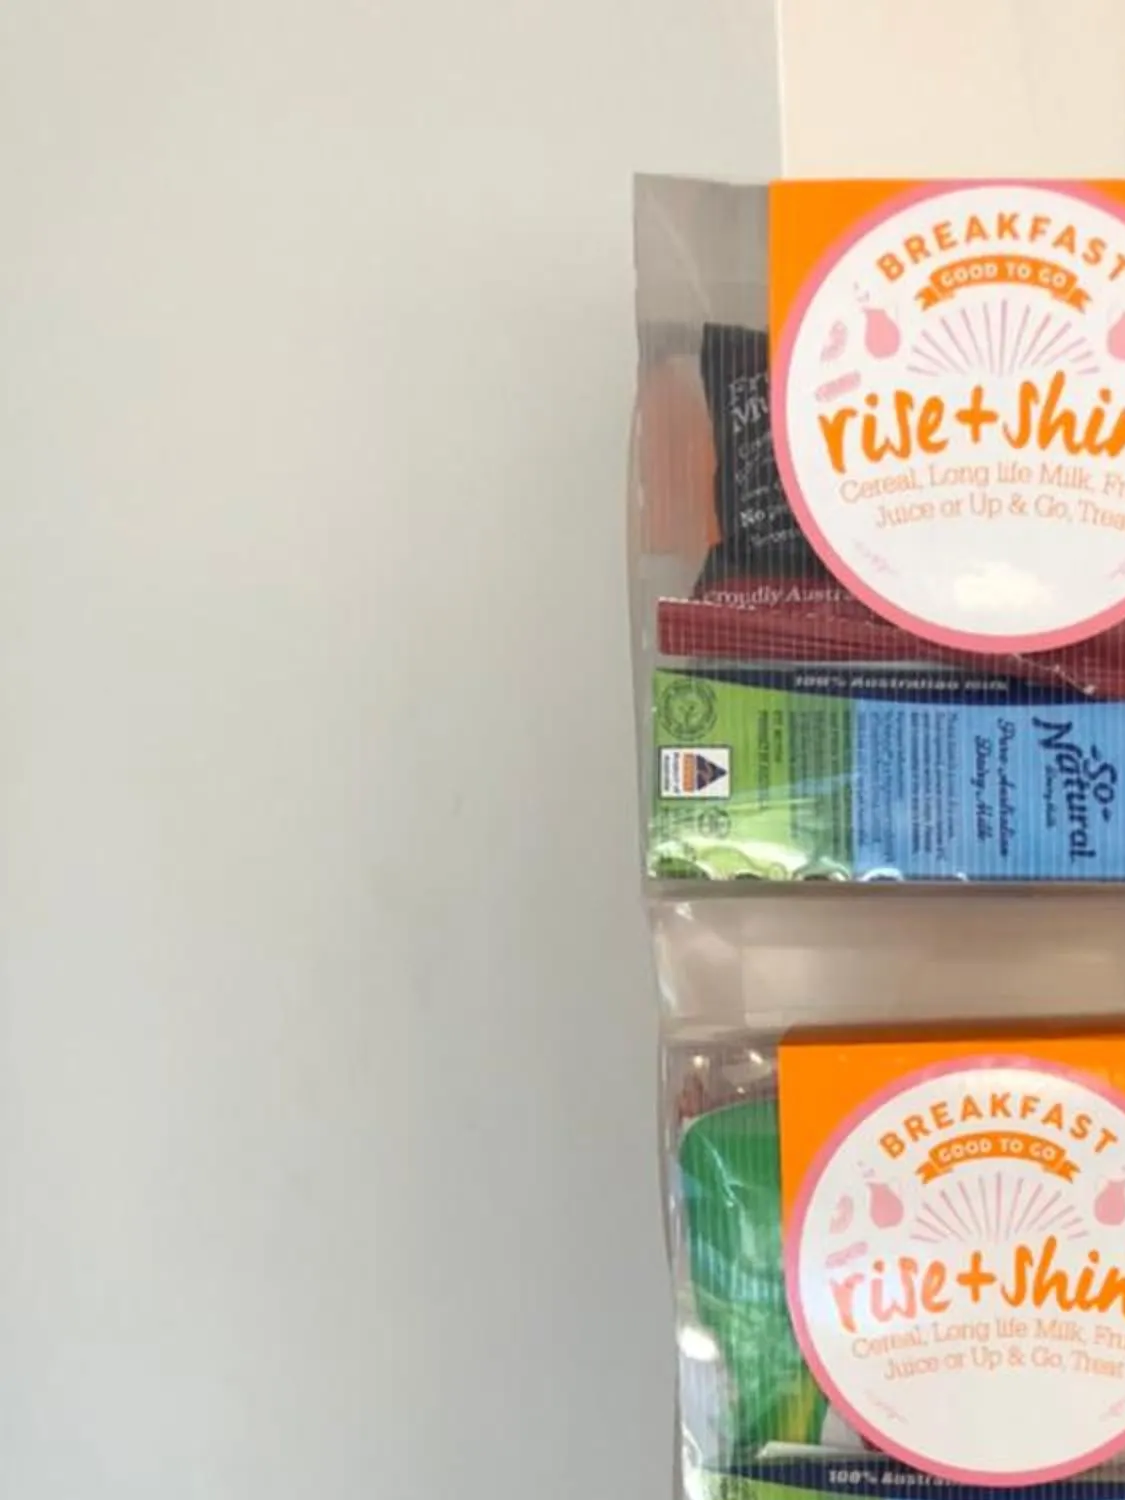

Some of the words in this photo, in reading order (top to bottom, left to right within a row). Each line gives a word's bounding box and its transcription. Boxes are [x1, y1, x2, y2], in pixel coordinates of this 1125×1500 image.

[940, 262, 998, 287] GOOD
[1005, 261, 1030, 281] TO
[1038, 267, 1068, 288] GO
[839, 473, 921, 504] Cereal,
[929, 461, 990, 489] Long
[997, 460, 1034, 484] life
[876, 499, 939, 529] Juice
[943, 501, 964, 519] or
[969, 493, 1001, 521] Up
[1008, 495, 1031, 515] &
[1032, 716, 1097, 862] Natural
[879, 1091, 1119, 1159] BREAKFAST
[938, 1138, 993, 1164] GOOD
[999, 1137, 1024, 1154] TO
[1030, 1142, 1057, 1162] GO
[852, 1327, 928, 1359] Cereal,
[934, 1318, 991, 1344] Long
[997, 1317, 1030, 1340] life
[884, 1352, 940, 1380] Juice
[945, 1354, 967, 1369] or
[971, 1347, 1002, 1373] Up
[1007, 1349, 1027, 1368] &
[1072, 1353, 1125, 1380] Treat
